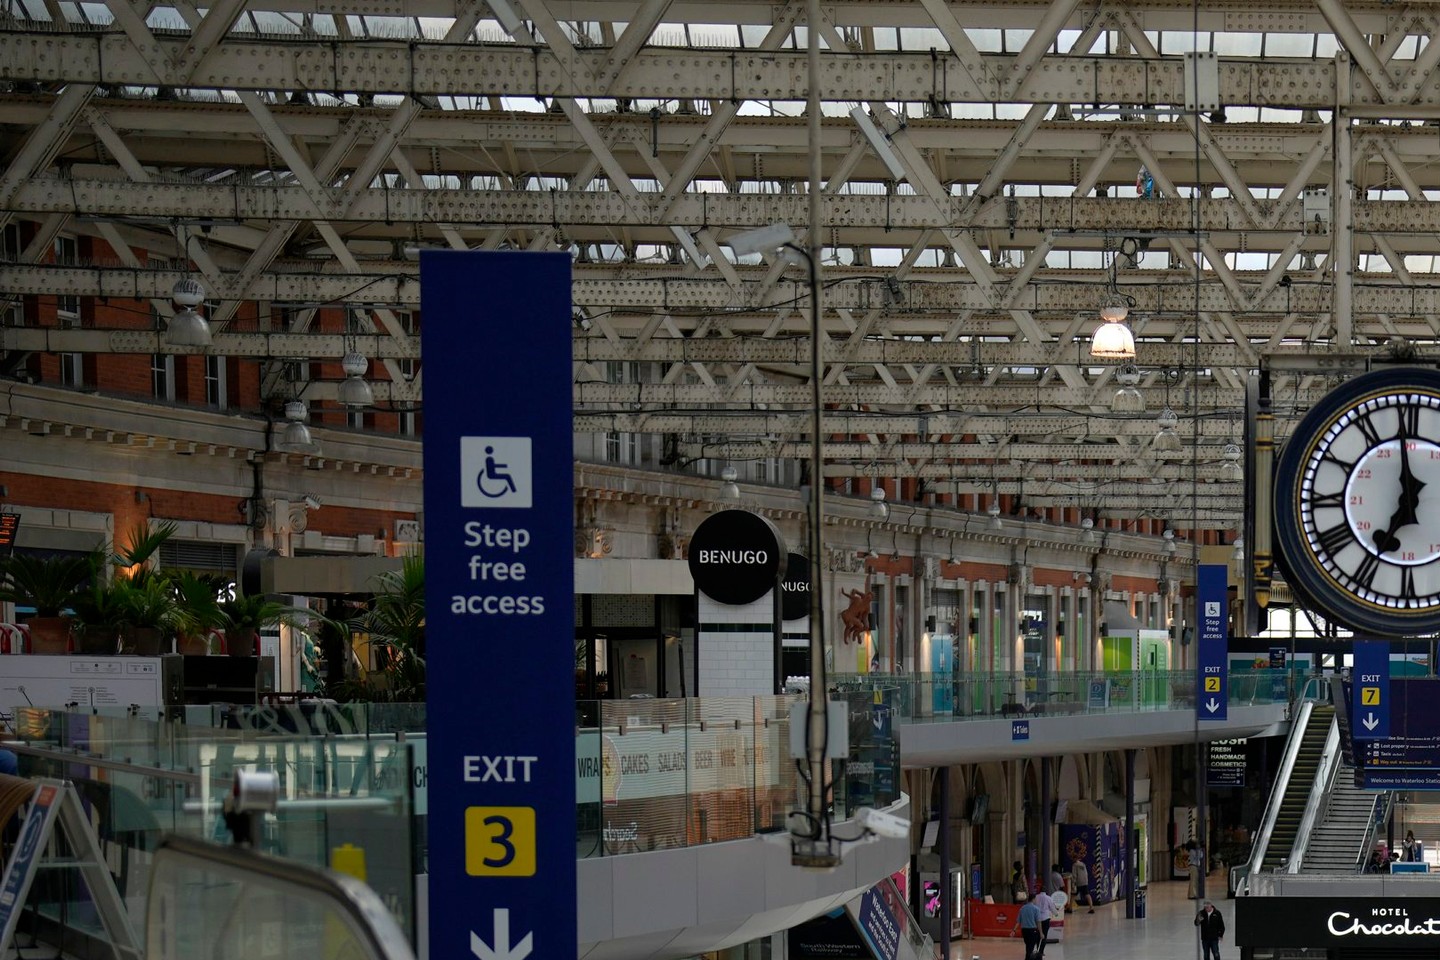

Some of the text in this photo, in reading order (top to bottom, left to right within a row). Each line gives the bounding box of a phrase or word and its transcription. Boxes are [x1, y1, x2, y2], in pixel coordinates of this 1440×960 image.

[1376, 449, 1391, 459] 23
[1357, 469, 1372, 479] 22
[1350, 496, 1363, 506] 21
[1356, 521, 1371, 531] 20
[463, 521, 531, 554] Step
[699, 549, 768, 565] BENUGO
[1401, 550, 1415, 561] 18
[468, 555, 527, 581] free
[451, 594, 546, 615] access
[1209, 679, 1216, 690] 2
[1366, 690, 1375, 703] 7
[463, 755, 539, 783] EXIT
[577, 756, 611, 778] WRAS
[621, 754, 649, 776] CAKES
[657, 751, 687, 773] SALADS
[695, 751, 713, 769] BEER
[483, 815, 516, 868] 3
[1371, 908, 1409, 917] HOTEL
